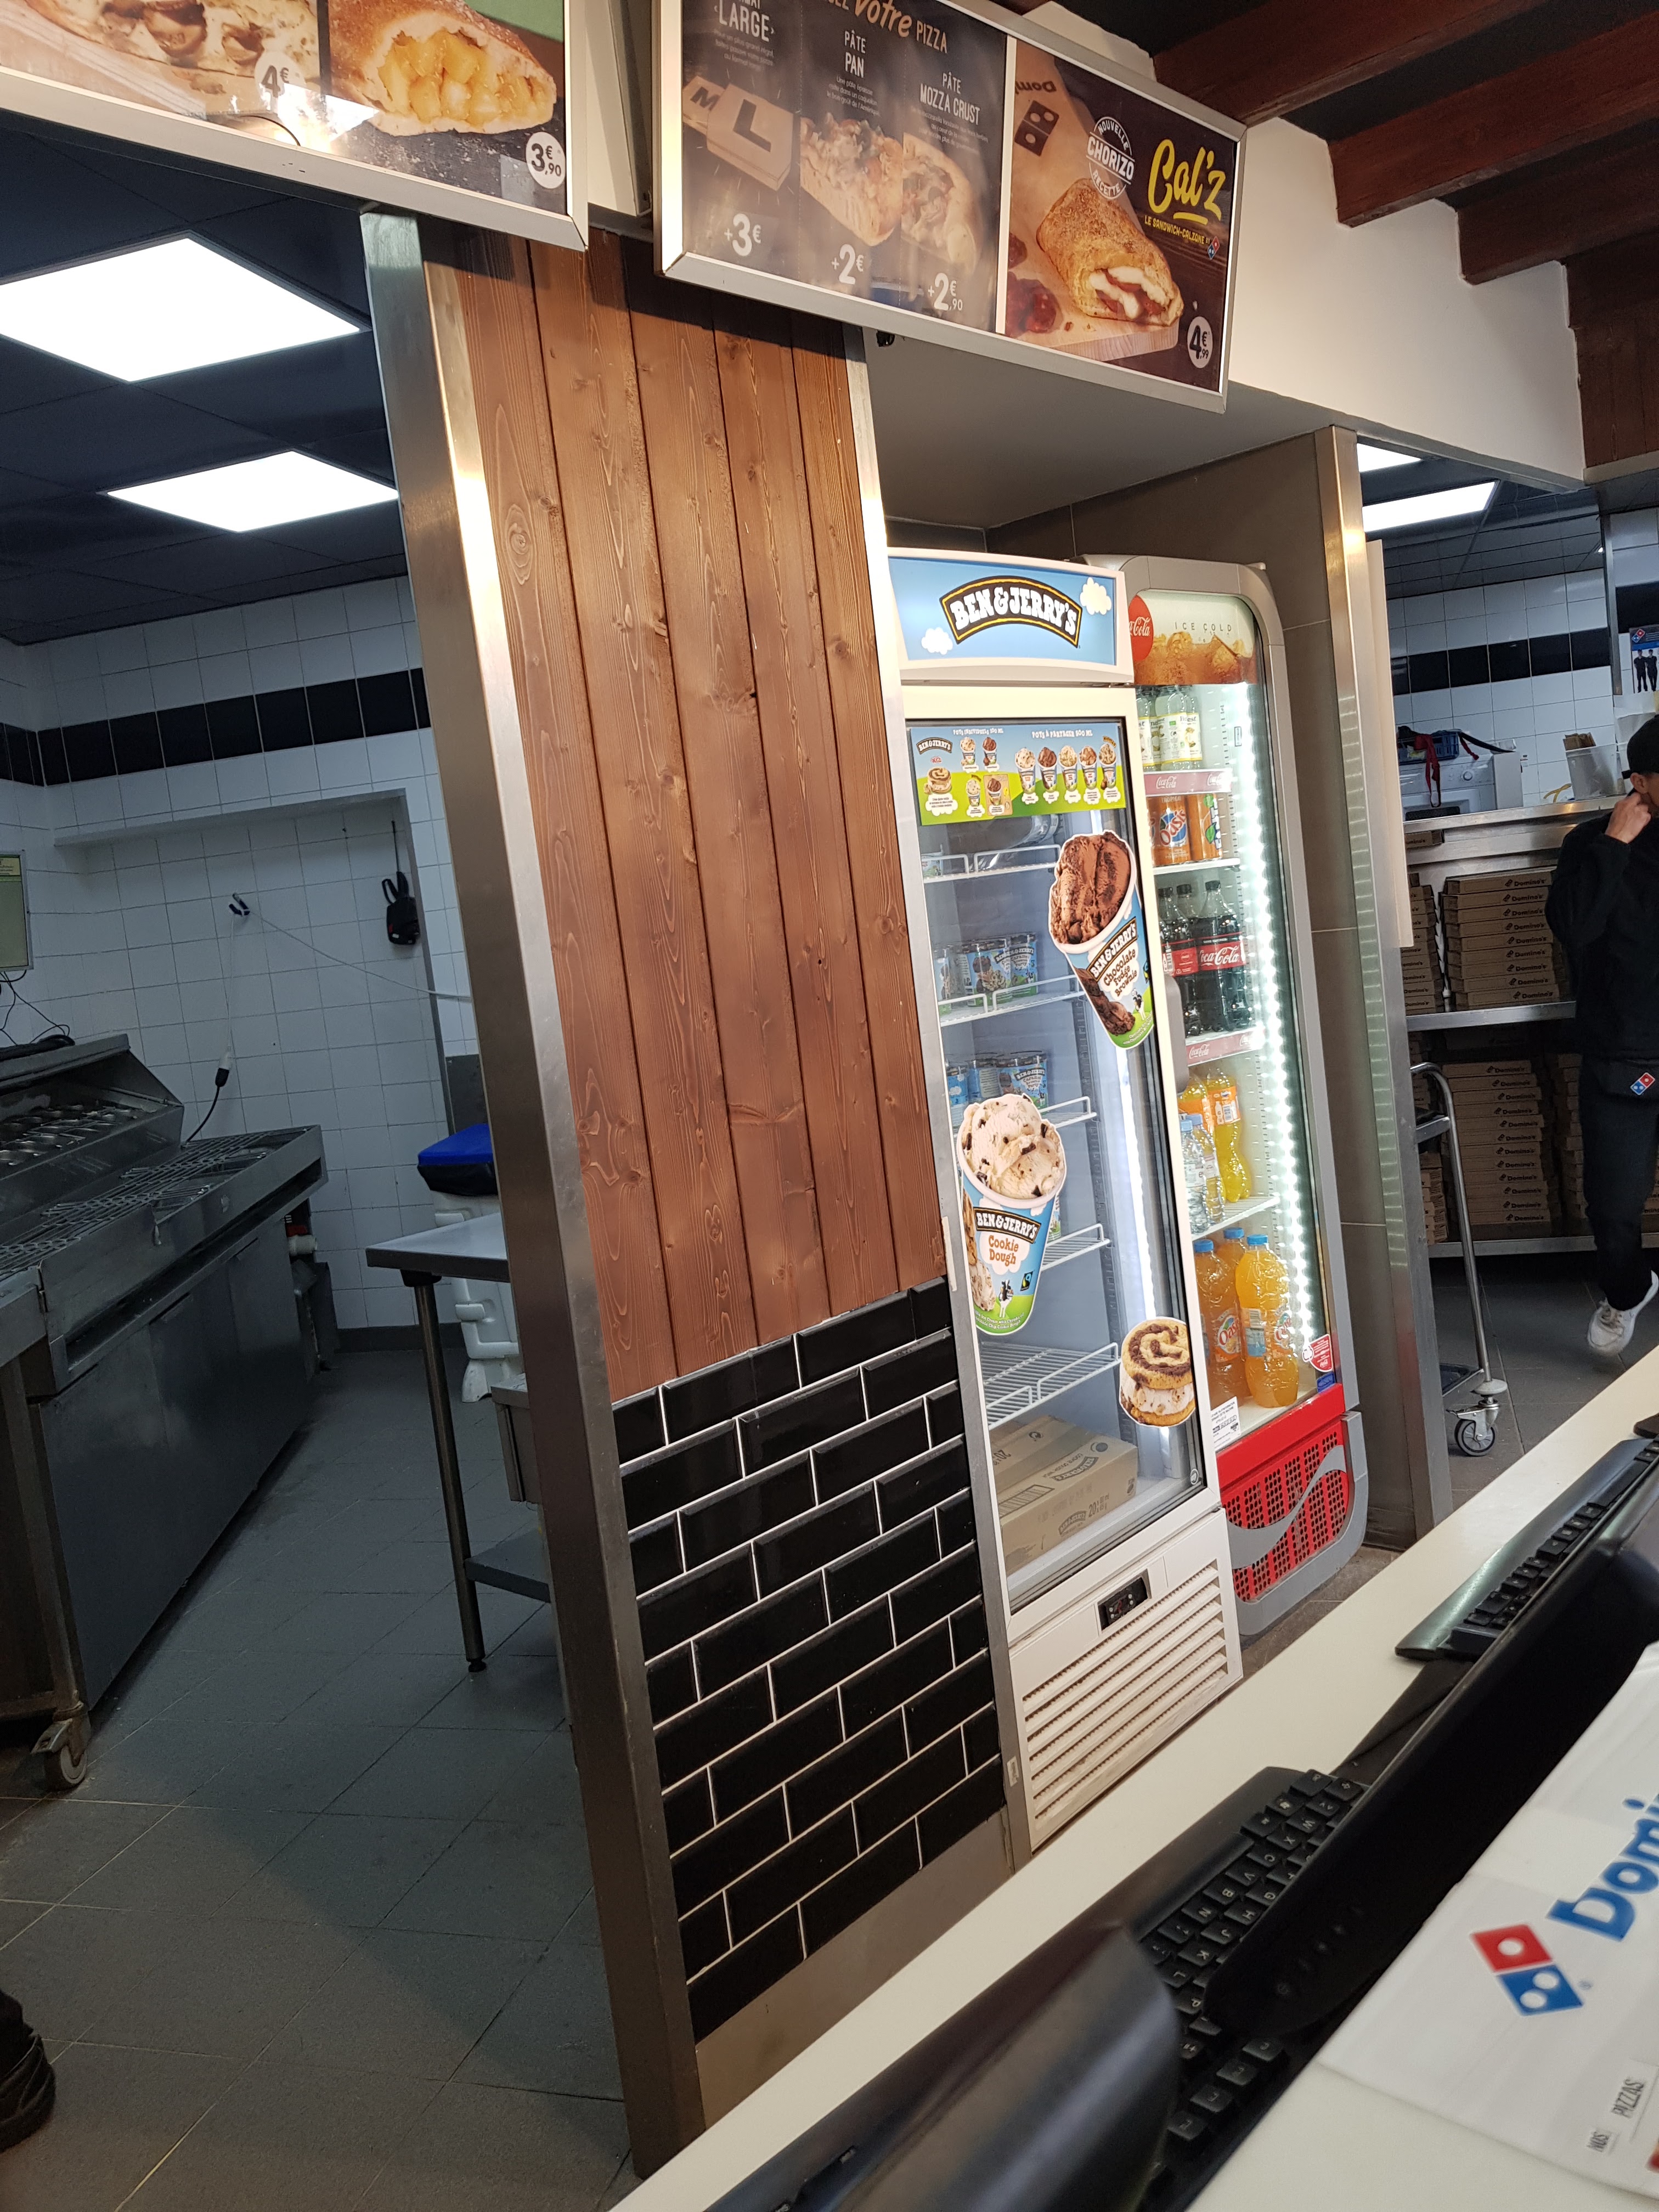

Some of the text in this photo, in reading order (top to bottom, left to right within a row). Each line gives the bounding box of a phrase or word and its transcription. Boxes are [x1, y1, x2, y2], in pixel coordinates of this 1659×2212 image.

[844, 30, 866, 54] PÂTE
[916, 20, 947, 54] PIZZA
[845, 52, 864, 78] PAN
[942, 71, 961, 95] PÂTE
[920, 83, 980, 126] MOZZA CRUST
[733, 99, 771, 153] L
[1098, 120, 1130, 151] NOUVELLE
[1087, 136, 1135, 180] CHORIZO
[1092, 170, 1121, 197] RECETTE
[1144, 215, 1152, 225] LE
[1175, 622, 1232, 632] ICE COLD
[1160, 810, 1186, 845] Oasis
[1514, 878, 1546, 887] Domino's
[1514, 922, 1545, 930] Domino's
[1515, 949, 1545, 957] Domino's
[1104, 949, 1136, 986] Chocolate
[1515, 963, 1546, 972] Domino's
[1115, 970, 1137, 997] Brownie
[1517, 977, 1548, 985] Domino's
[1522, 991, 1553, 999] Domino's
[988, 1234, 1019, 1253] Cookie
[989, 1248, 1016, 1267] Dough
[1587, 2078, 1646, 2153] NOS PIZZAS
